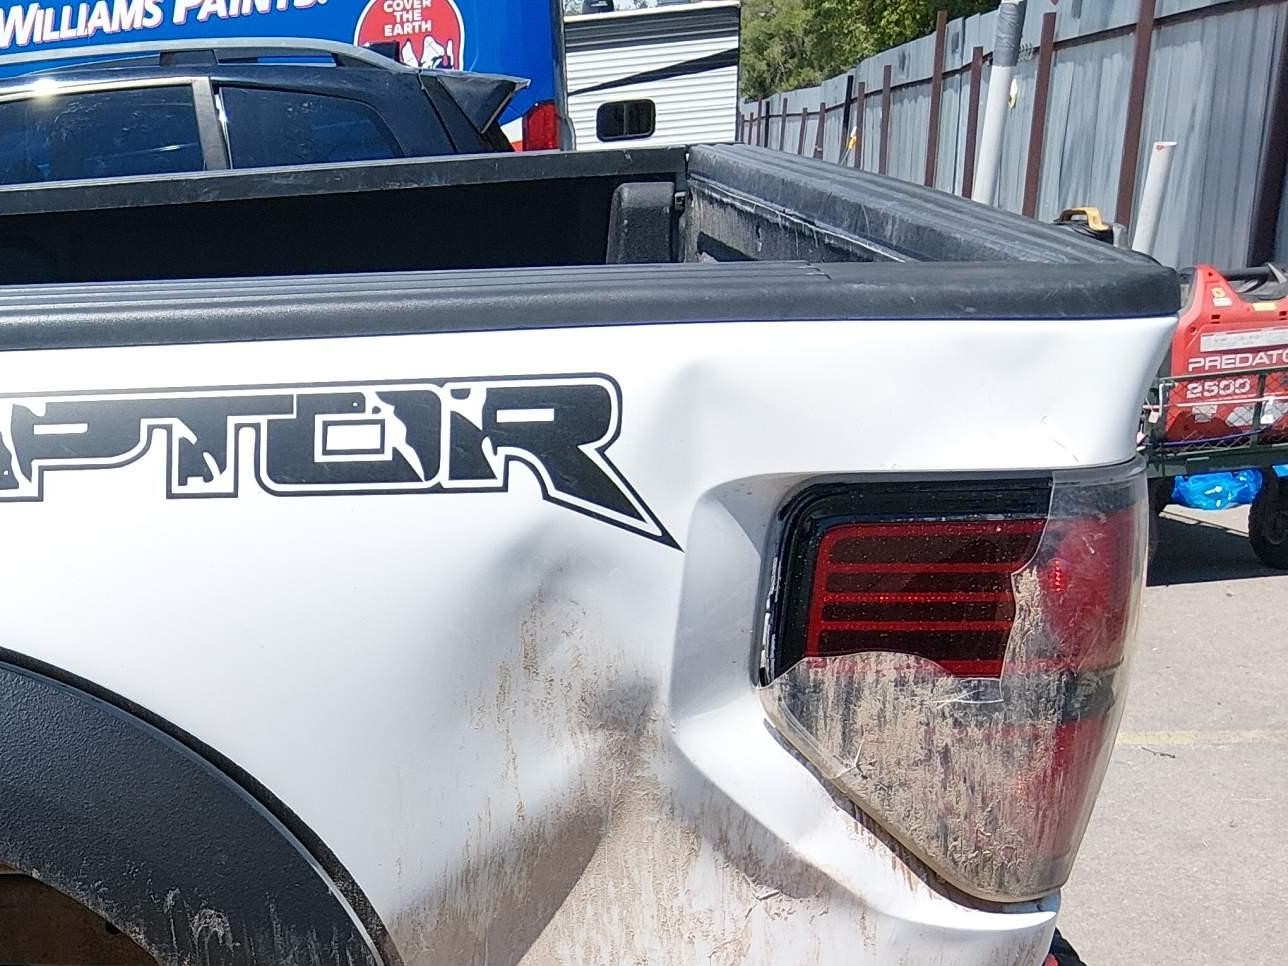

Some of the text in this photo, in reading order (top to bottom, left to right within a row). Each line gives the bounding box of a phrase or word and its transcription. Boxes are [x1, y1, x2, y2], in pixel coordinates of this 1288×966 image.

[172, 0, 329, 25] PAI.
[393, 9, 422, 23] THE
[384, 20, 432, 36] EARTH
[1187, 378, 1251, 399] 2500
